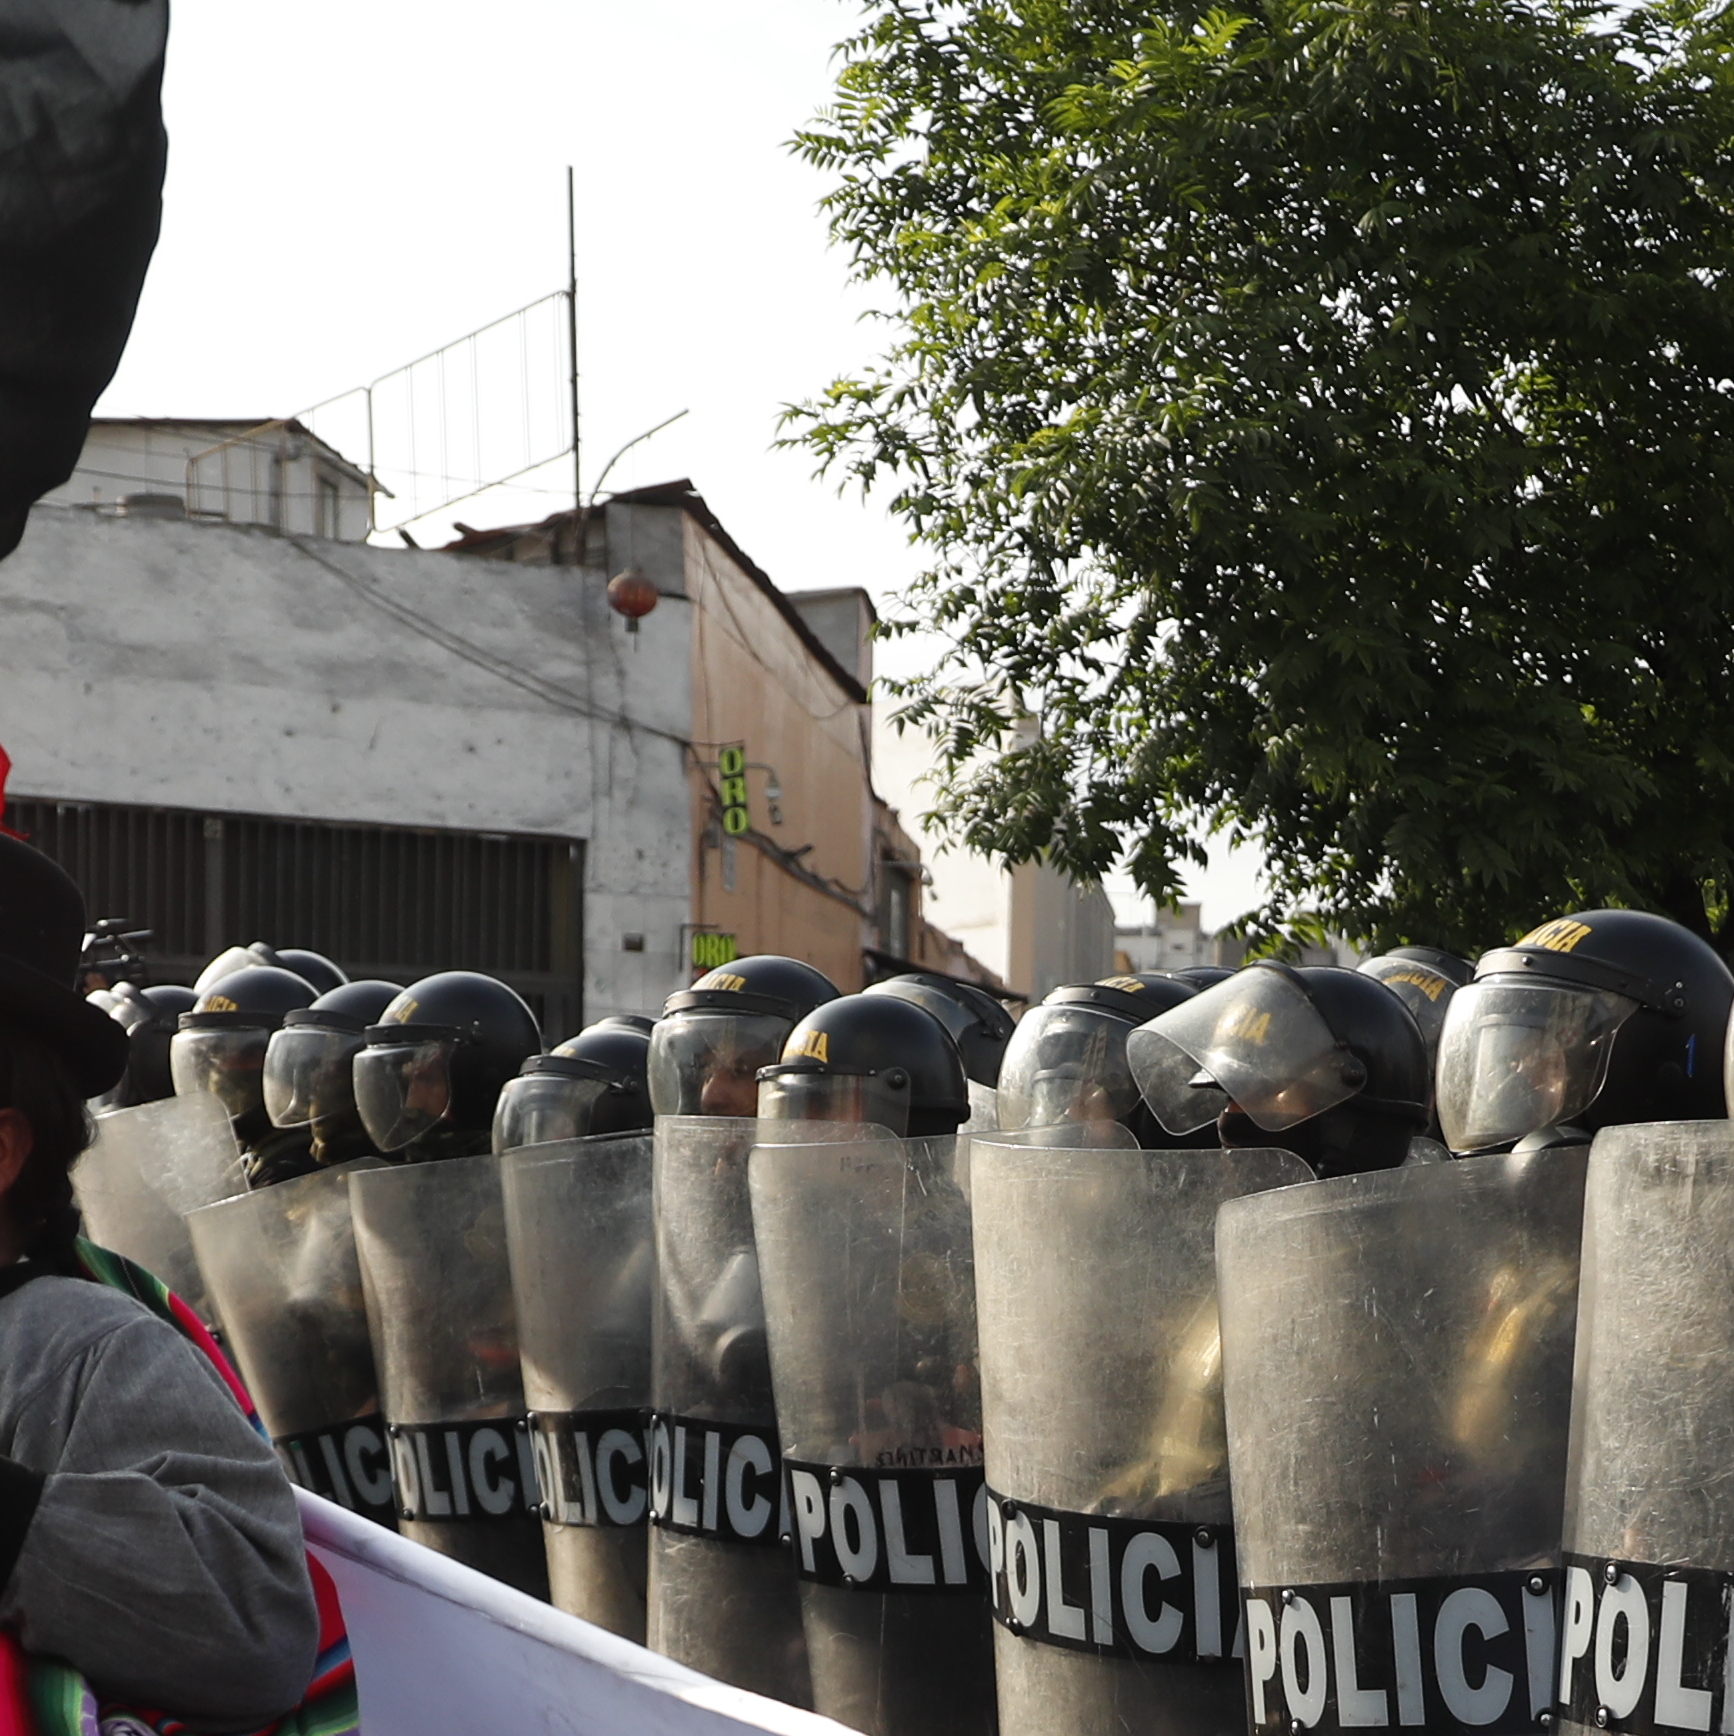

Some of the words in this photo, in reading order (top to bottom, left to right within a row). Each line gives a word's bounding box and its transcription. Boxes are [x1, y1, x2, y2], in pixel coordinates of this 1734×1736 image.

[718, 746, 749, 836] ORO
[692, 933, 736, 968] ORO
[988, 1494, 1242, 1658] POLICI
